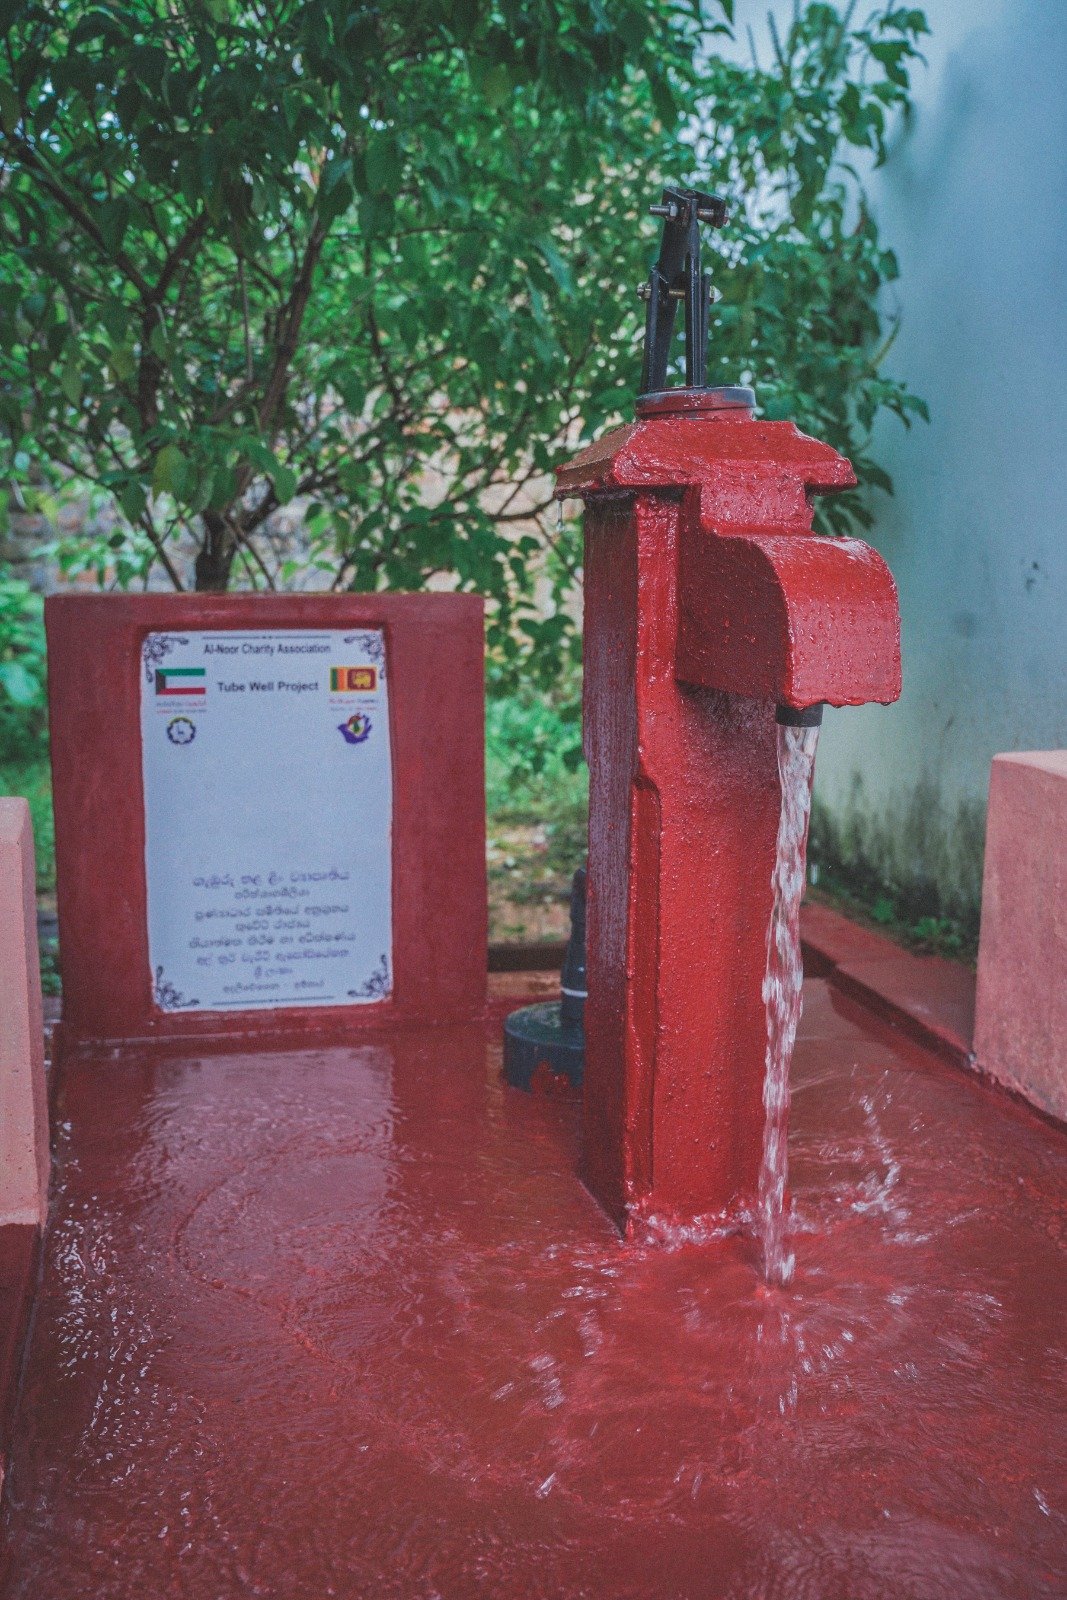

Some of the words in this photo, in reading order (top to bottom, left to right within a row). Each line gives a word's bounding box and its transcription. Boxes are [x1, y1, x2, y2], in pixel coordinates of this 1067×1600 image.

[204, 644, 239, 654] Al-Noor
[242, 644, 274, 656] Charity
[278, 644, 331, 654] Association
[216, 682, 245, 692] Tube
[249, 682, 274, 692] Well
[278, 681, 319, 694] Project
